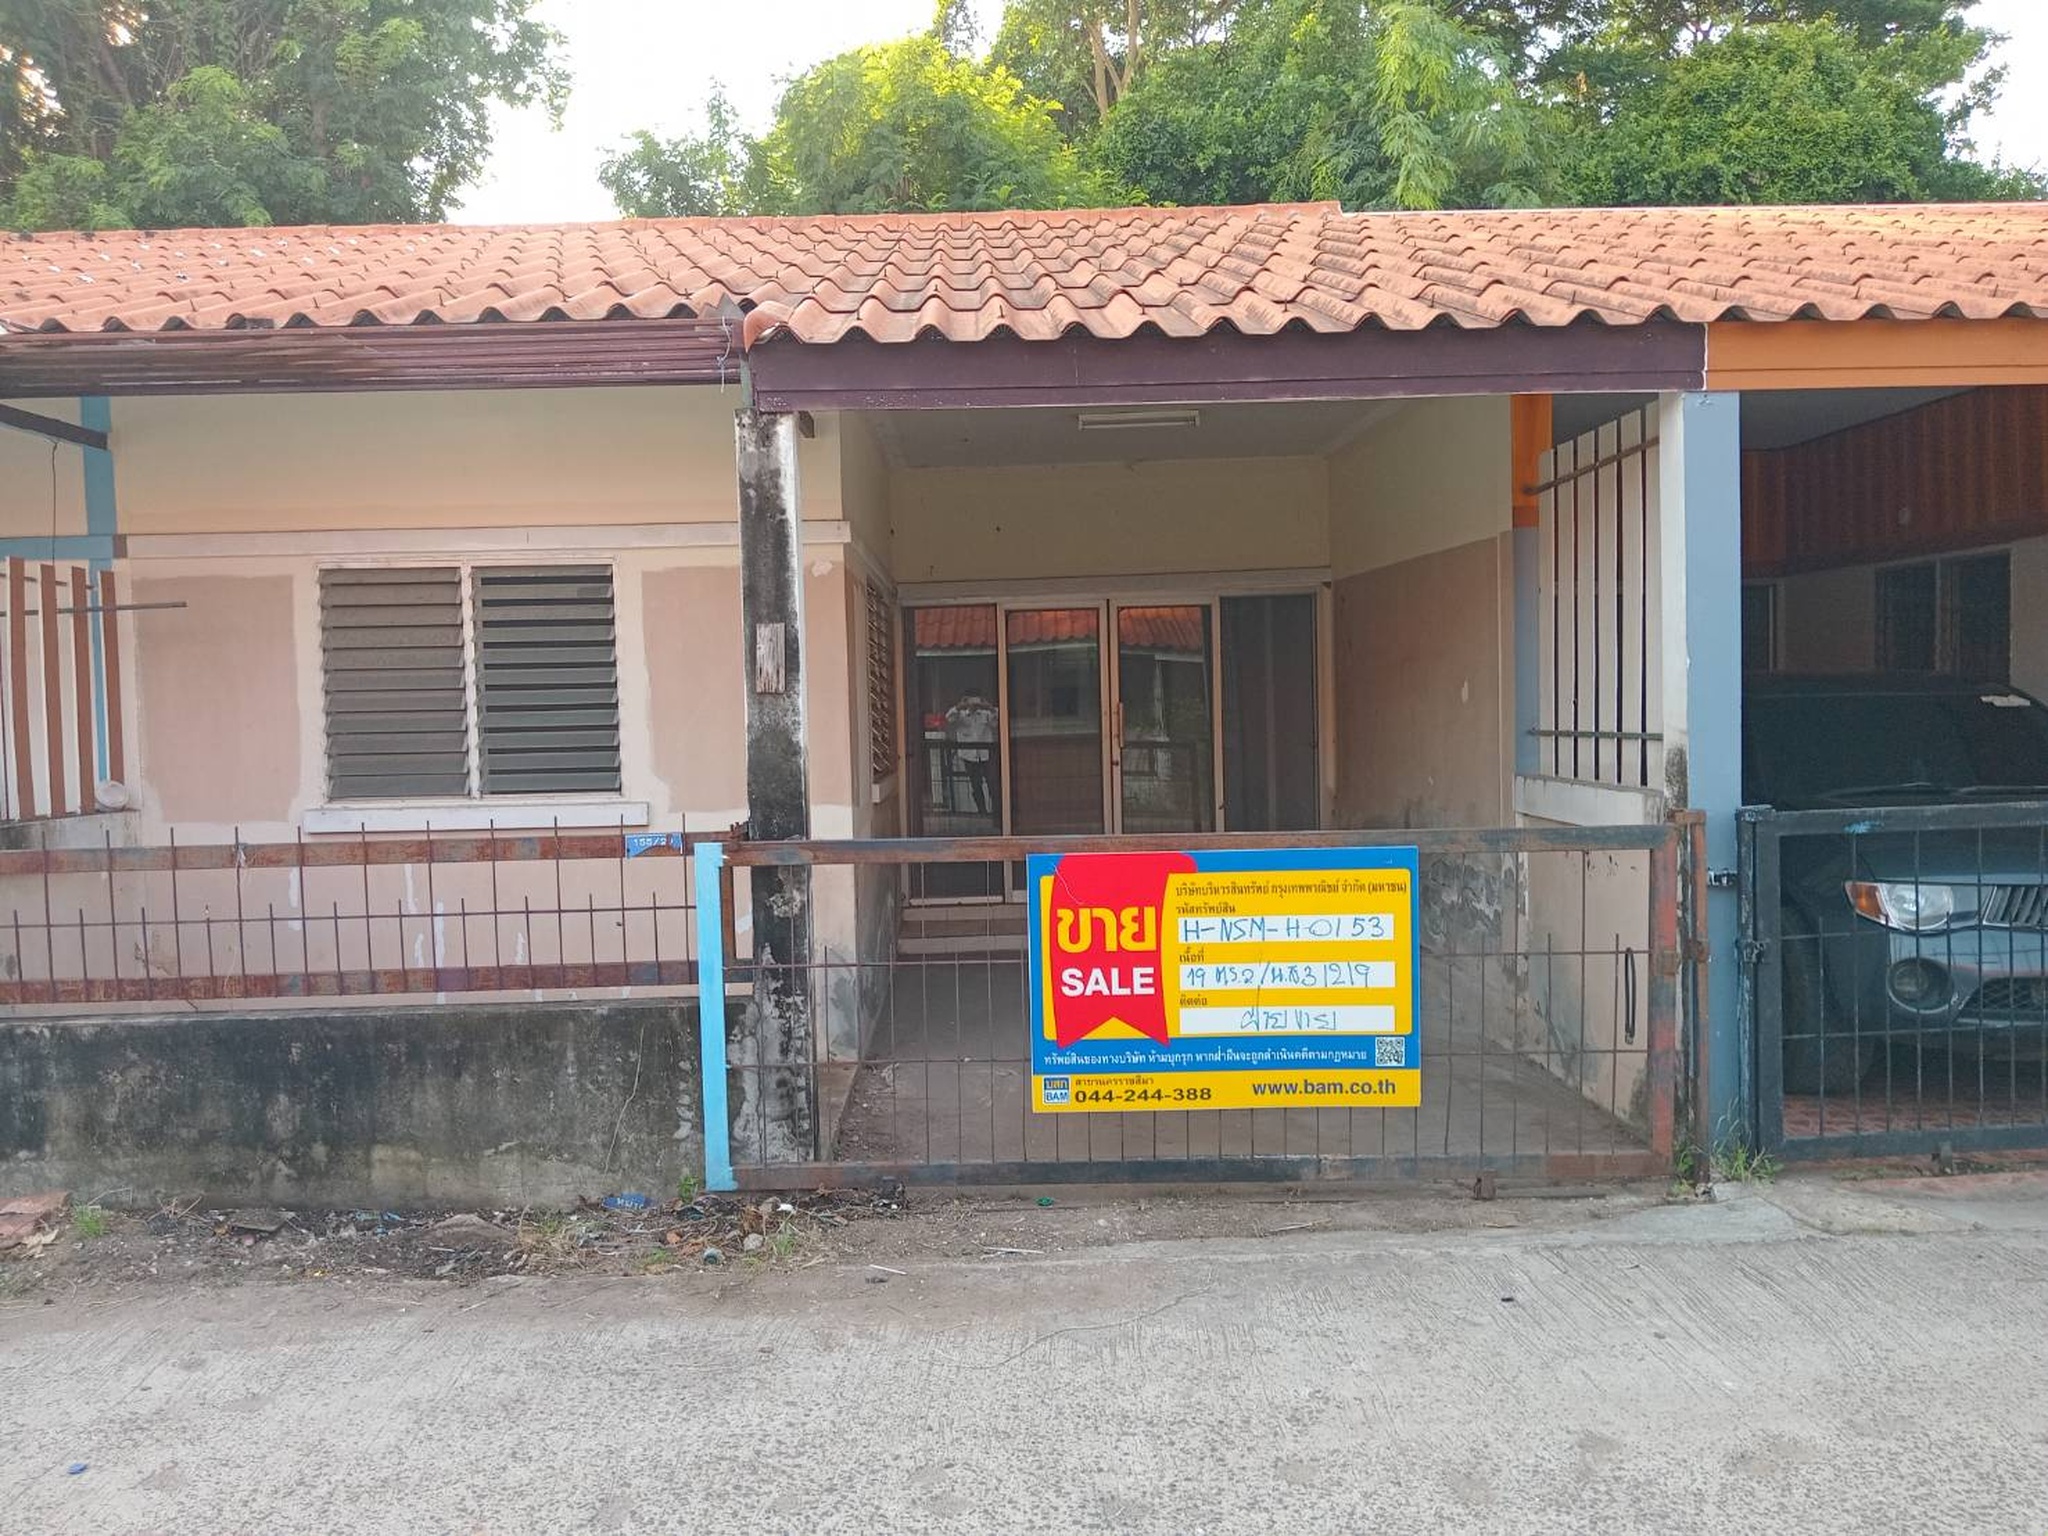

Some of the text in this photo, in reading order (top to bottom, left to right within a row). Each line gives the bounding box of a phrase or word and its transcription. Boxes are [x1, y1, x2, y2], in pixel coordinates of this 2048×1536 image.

[1341, 879, 1366, 893] จำกัด
[1368, 881, 1407, 894] (มหาชน)
[1176, 902, 1236, 914] รหัสทรัพย์สิน
[1057, 906, 1156, 954] ขาย
[1179, 947, 1205, 963] เนื้อที่
[1061, 967, 1155, 997] SALE
[1187, 967, 1206, 988] 19
[1179, 994, 1208, 1006] ติดต่อ
[1044, 1050, 1146, 1065] ทรัพย์สินของทางบริษัท
[1147, 1049, 1192, 1067] ห้ามบุกรุก
[1075, 1087, 1212, 1103] 044-244-388
[1252, 1079, 1396, 1095] www.bam.co.th
[1045, 1091, 1068, 1101] BAM
